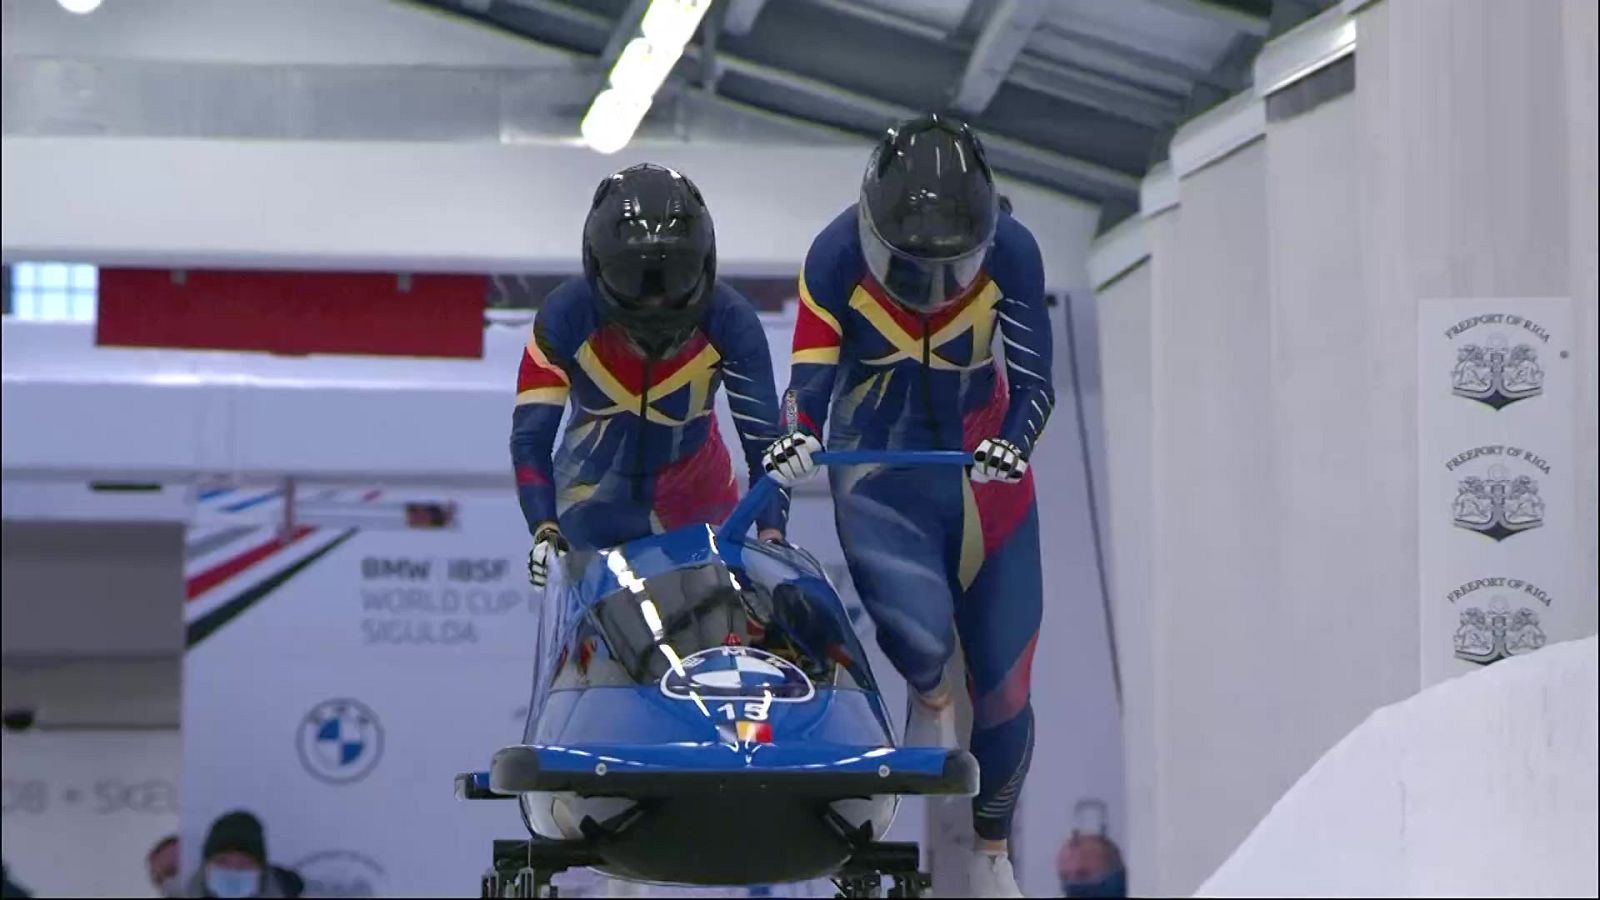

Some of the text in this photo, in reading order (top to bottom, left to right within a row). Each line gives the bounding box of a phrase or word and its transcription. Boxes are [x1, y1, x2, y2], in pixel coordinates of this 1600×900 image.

[1445, 313, 1550, 342] FREEPORT OF RIGA
[1445, 445, 1551, 474] FREEPORT OF RIGA
[361, 557, 431, 580] BMW
[1446, 577, 1552, 607] FREEPORT OF RIGA
[717, 703, 771, 721] 15
